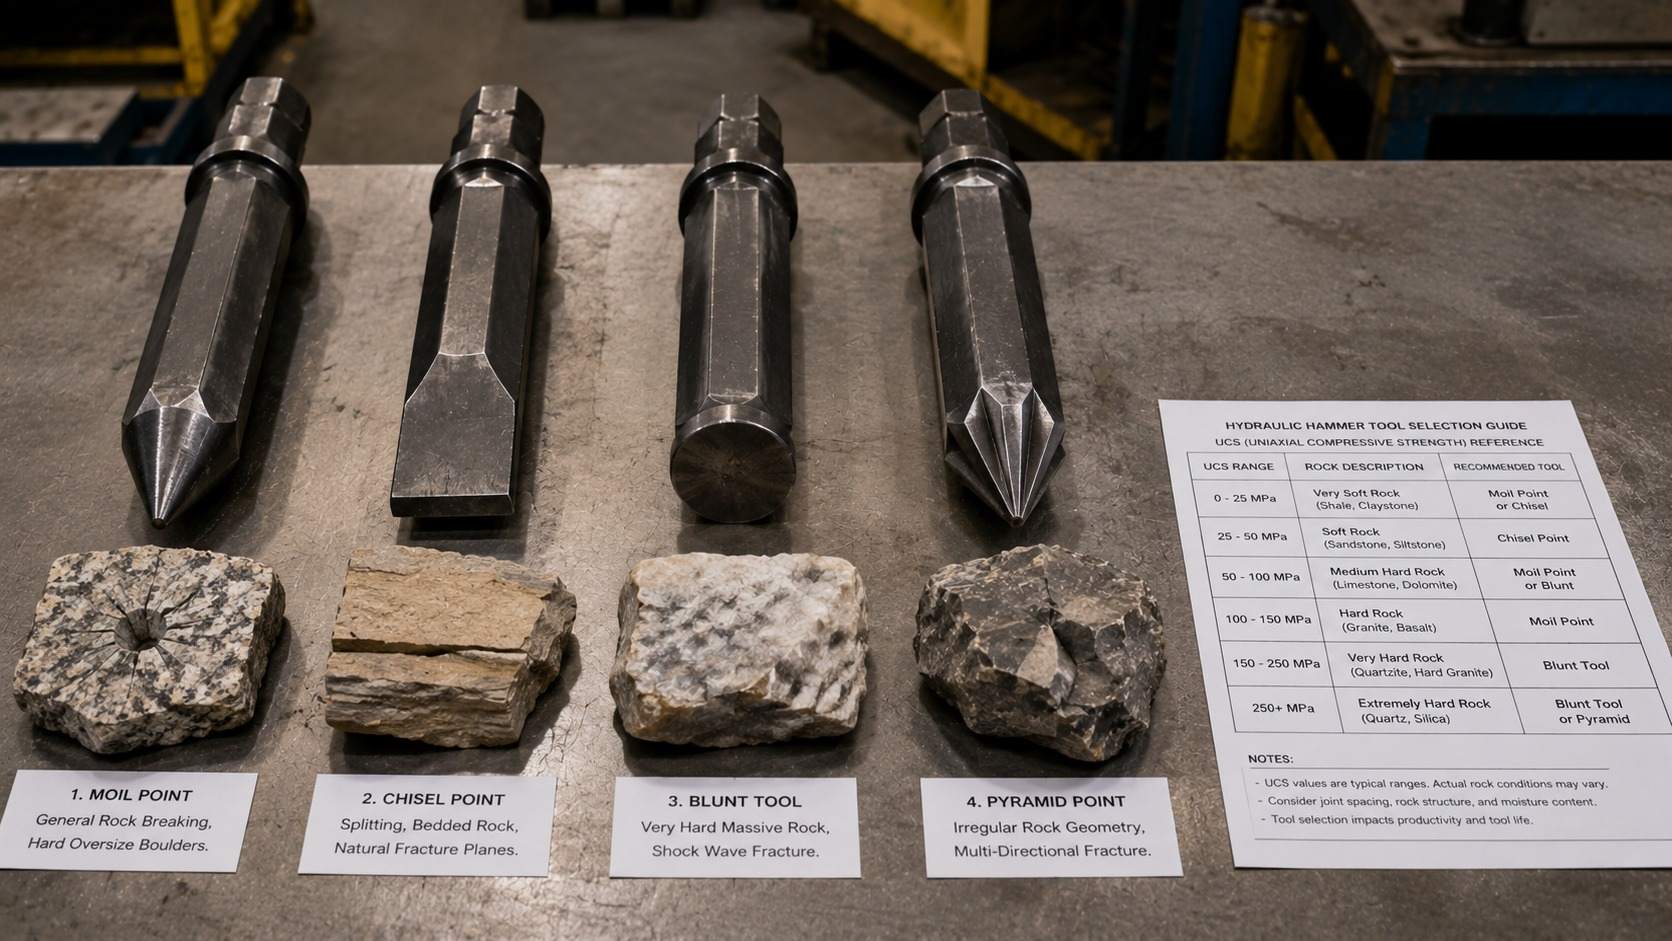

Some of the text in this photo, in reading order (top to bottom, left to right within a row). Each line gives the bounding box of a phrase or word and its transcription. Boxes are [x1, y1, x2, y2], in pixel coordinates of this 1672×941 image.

[1225, 422, 1527, 430] HYDRAULIC HAMMER TOOL SELECTION GUIDE
[1215, 438, 1544, 448] UCS (UNIAXIAL COMPRESSIVE STRENGTH) REFERENCE
[1203, 462, 1274, 471] UCS RANGE
[1305, 463, 1424, 471] ROCK DESCRIPTION
[1453, 463, 1565, 472] RECOMMENDED TOOL
[1214, 494, 1222, 502] 0
[1233, 494, 1247, 503] 25
[1250, 494, 1277, 503] MPa
[1313, 489, 1400, 499] Very Soft Rock
[1488, 489, 1549, 498] Moil Point
[1316, 501, 1418, 512] (Shale, Claystone)
[1510, 501, 1549, 510] Chisel
[1218, 532, 1232, 541] 25
[1244, 532, 1258, 541] 50
[1261, 532, 1288, 541] MPa
[1322, 527, 1380, 536] Soft Rock
[1497, 533, 1570, 543] Chisel Point
[1324, 539, 1446, 552] (Sandstone, Siltstone)
[1222, 572, 1237, 581] 50
[1249, 572, 1270, 581] 100
[1273, 573, 1300, 581] MPa
[1330, 567, 1445, 576] Medium Hard Rock
[1513, 568, 1576, 577] Moil Point
[1333, 579, 1458, 592] (Limestone, Dolomite)
[1541, 581, 1575, 590] Blunt
[1339, 609, 1404, 618] Hard Rock
[1226, 614, 1248, 624] 100
[1260, 615, 1281, 624] 150
[1285, 615, 1312, 624] MPa
[1529, 617, 1594, 626] Moil Point
[1342, 622, 1437, 634] (Granite, Basalt)
[1347, 653, 1444, 664] Very Hard Rock
[1233, 659, 1255, 668] 150
[1266, 659, 1290, 668] 250
[1293, 659, 1321, 669] MPa
[1543, 661, 1610, 670] Blunt Tool
[1351, 666, 1493, 680] (Quartzite, Hard Granite)
[1252, 703, 1315, 713] 250+ MPa
[1358, 698, 1491, 711] Extremely Hard Rock
[1555, 699, 1623, 709] Blunt Tool
[1361, 712, 1450, 725] (Quartz, Silica)
[1559, 713, 1631, 726] or Pyramid
[1248, 754, 1293, 764] NOTES:
[1264, 779, 1290, 788] UCS
[1293, 779, 1327, 789] values
[1350, 779, 1387, 791] typical
[1389, 781, 1430, 791] ranges.
[1433, 780, 1467, 789] Actual
[1470, 780, 1495, 789] rock
[1497, 780, 1553, 789] conditions
[1555, 781, 1578, 791] may
[1581, 782, 1608, 791] vary.
[72, 788, 193, 802] 1. MOIL POINT
[362, 793, 506, 806] 2. CHISEL POINT
[668, 795, 802, 808] 3. BLUNT TOOL
[966, 795, 1126, 808] 4. PYRAMID POINT
[1268, 796, 1317, 806] Consider
[1320, 797, 1342, 808] joint
[1346, 797, 1393, 809] spacing,
[1395, 798, 1420, 807] rock
[1422, 798, 1475, 808] structure,
[1477, 797, 1499, 807] and
[1501, 798, 1549, 807] moisture
[1551, 798, 1597, 807] content.
[36, 813, 212, 830] General Rock Breaking,
[1271, 814, 1296, 824] Tool
[1298, 815, 1348, 824] selection
[1352, 815, 1395, 826] impacts
[1397, 815, 1462, 827] productivity
[1465, 815, 1486, 825] and
[1488, 815, 1511, 825] tool
[1513, 815, 1533, 825] life.
[340, 818, 518, 834] Splitting, Bedded Rock,
[641, 821, 830, 836] Very Hard Massive Rock,
[954, 821, 1145, 837] Irregular Rock Geometry,
[28, 837, 208, 852] Hard Oversize Boulders.
[334, 842, 518, 856] Natural Fracture Planes.
[652, 844, 819, 858] Shock Wave Fracture.
[954, 844, 1151, 857] Multi-Directional Fracture.
